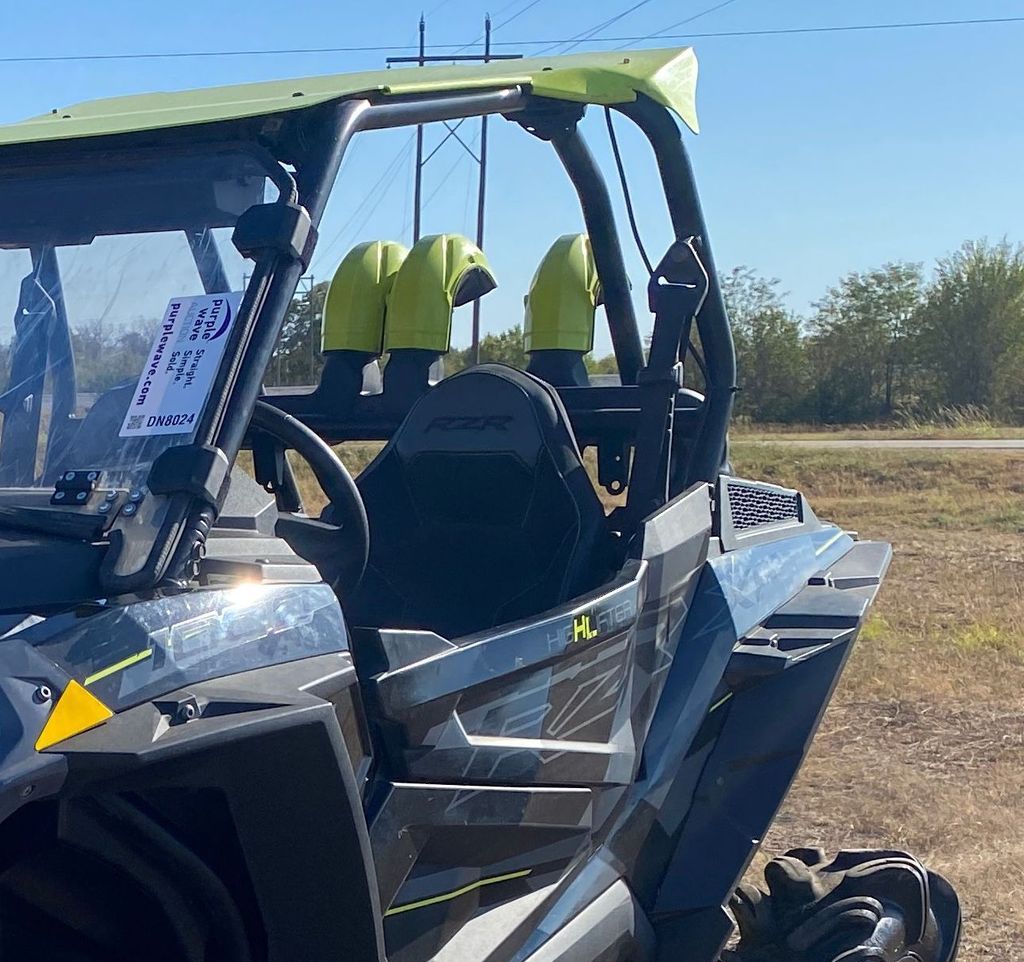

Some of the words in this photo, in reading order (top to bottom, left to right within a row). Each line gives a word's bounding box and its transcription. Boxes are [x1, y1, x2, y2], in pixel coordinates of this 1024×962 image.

[189, 307, 209, 341] wave
[202, 299, 224, 341] purple
[136, 302, 182, 406] purplewave.com
[164, 351, 181, 375] Sold.
[172, 350, 194, 386] Simple.
[182, 348, 206, 390] Straight.
[146, 413, 196, 428] DN8024
